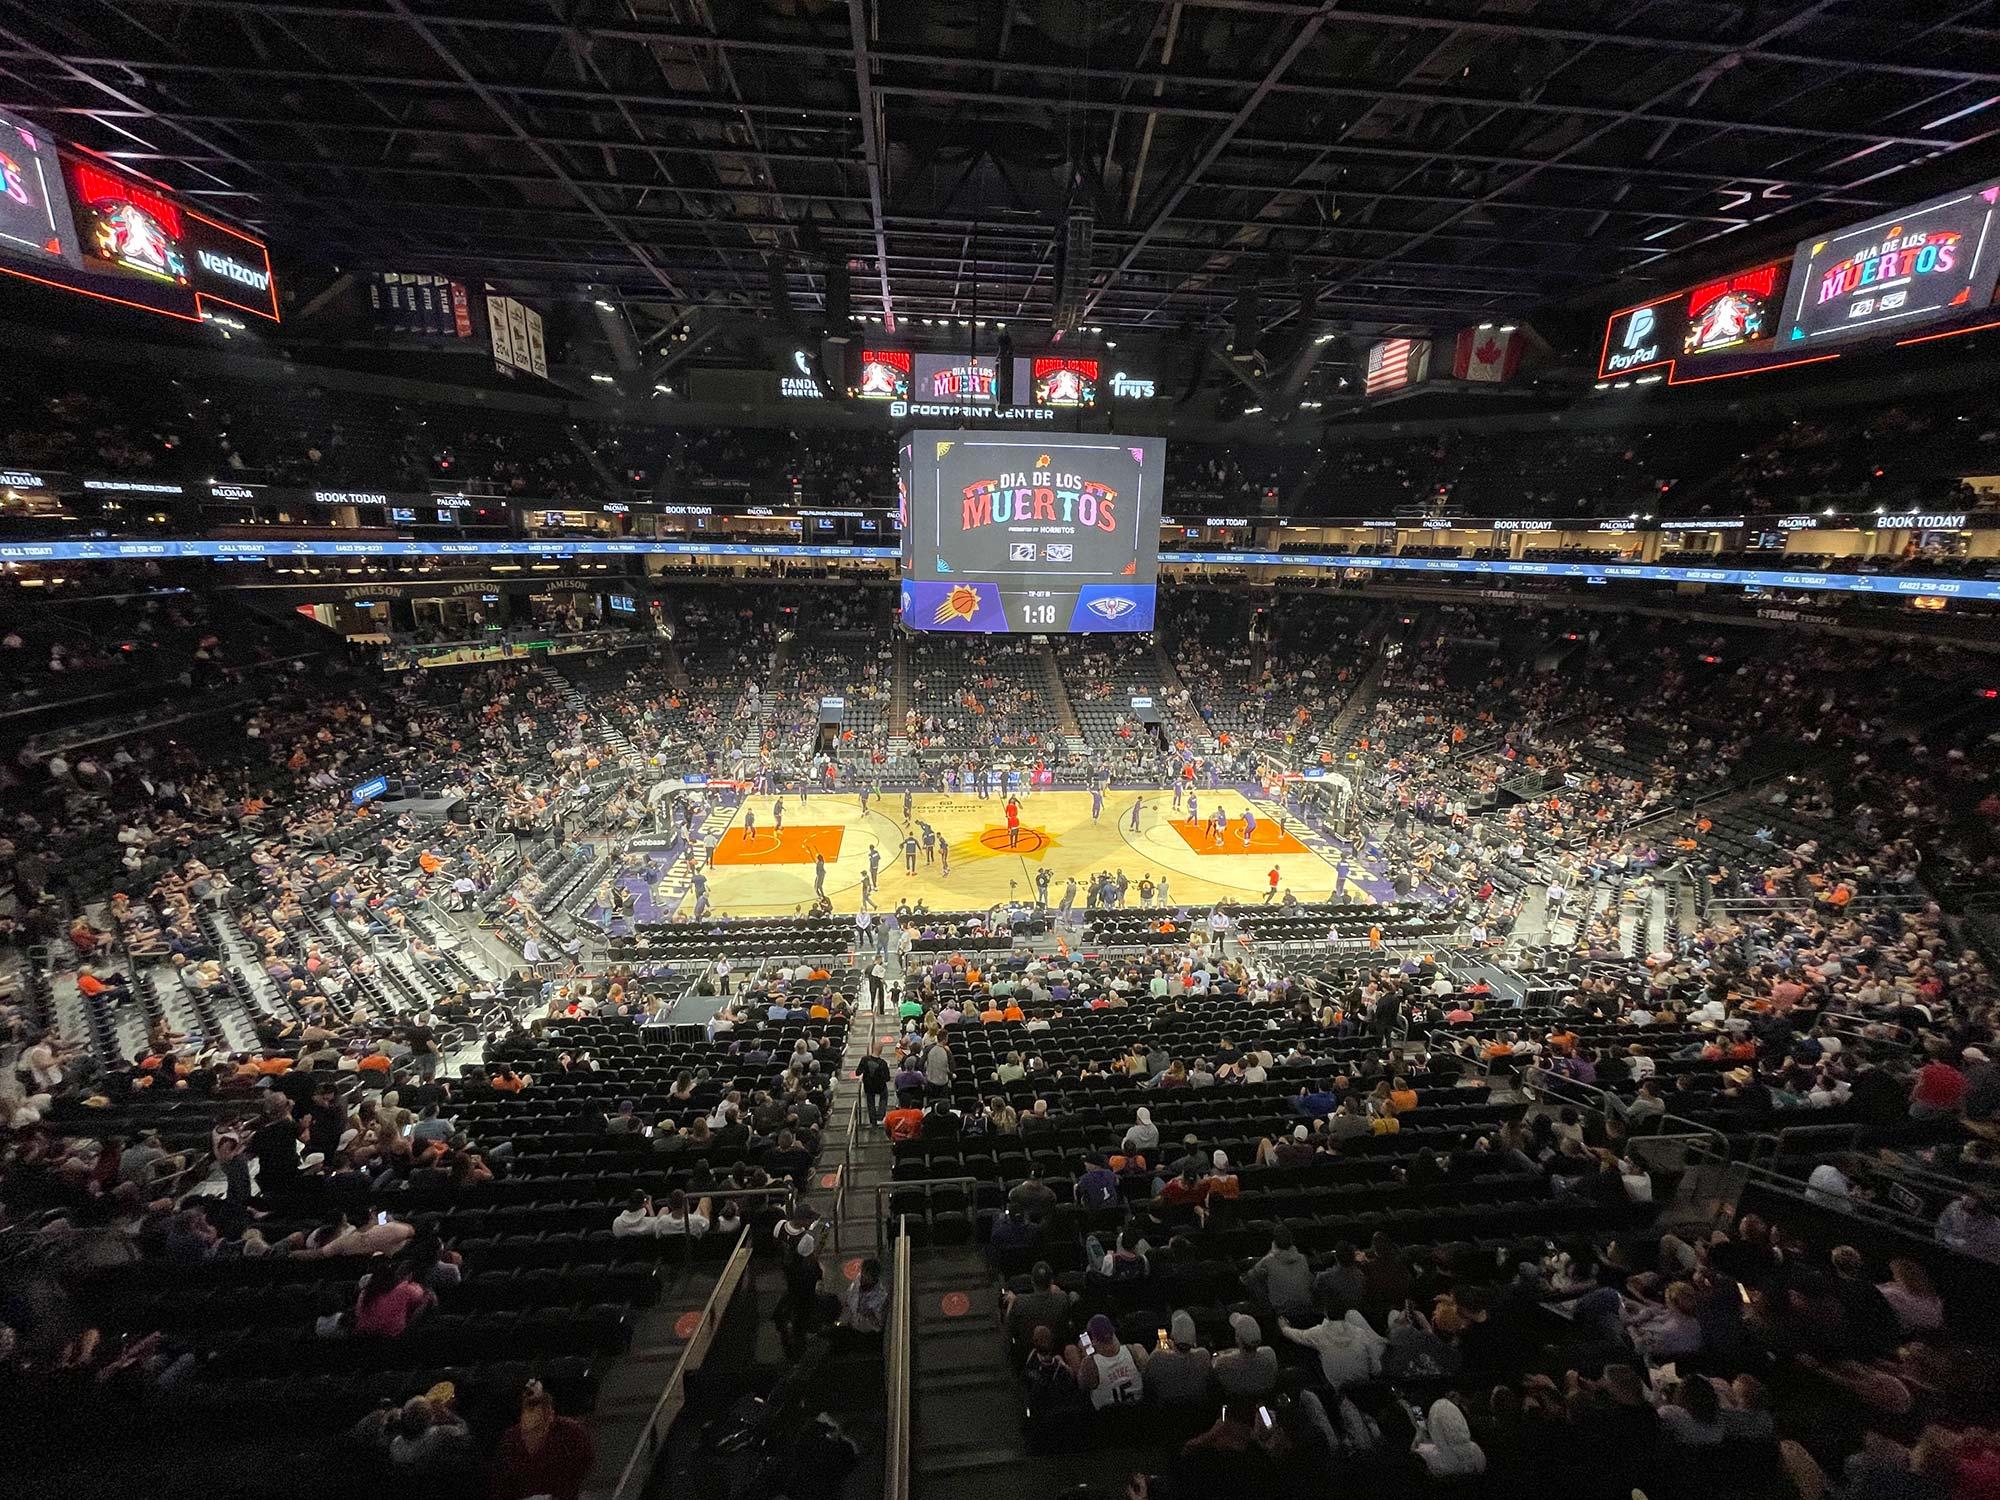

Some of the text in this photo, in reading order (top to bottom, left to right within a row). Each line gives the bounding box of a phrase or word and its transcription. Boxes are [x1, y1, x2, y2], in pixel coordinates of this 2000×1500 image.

[1854, 233, 1927, 263] DIA DE LOS
[198, 250, 267, 290] verizon
[1818, 245, 1957, 304] MUERTOS
[1608, 346, 1657, 370] PayPal
[952, 367, 966, 376] DIA
[910, 404, 992, 417] FOOTPRINT
[0, 475, 44, 487] ALOMAR
[1000, 471, 1082, 490] DIA DE LOS
[211, 488, 254, 498] PALOMAR
[316, 492, 387, 505] BOOK TODAY!
[437, 499, 471, 507] PALOMAR
[665, 506, 712, 515] BOOK TODAY!
[962, 488, 1117, 532] MUERTOS
[1206, 518, 1248, 527] BOOK TODAY!
[1494, 520, 1552, 530] BOOK TODAY!
[1877, 516, 1966, 528] BOOK TODAY!
[1040, 526, 1075, 535] HORNITOS
[545, 580, 588, 592] JAMESON
[1783, 576, 1800, 584] CALL
[345, 586, 402, 599] JAMESON
[451, 583, 500, 596] JAMESON
[1023, 605, 1056, 624] 1:18
[1102, 1187, 1111, 1200] 1
